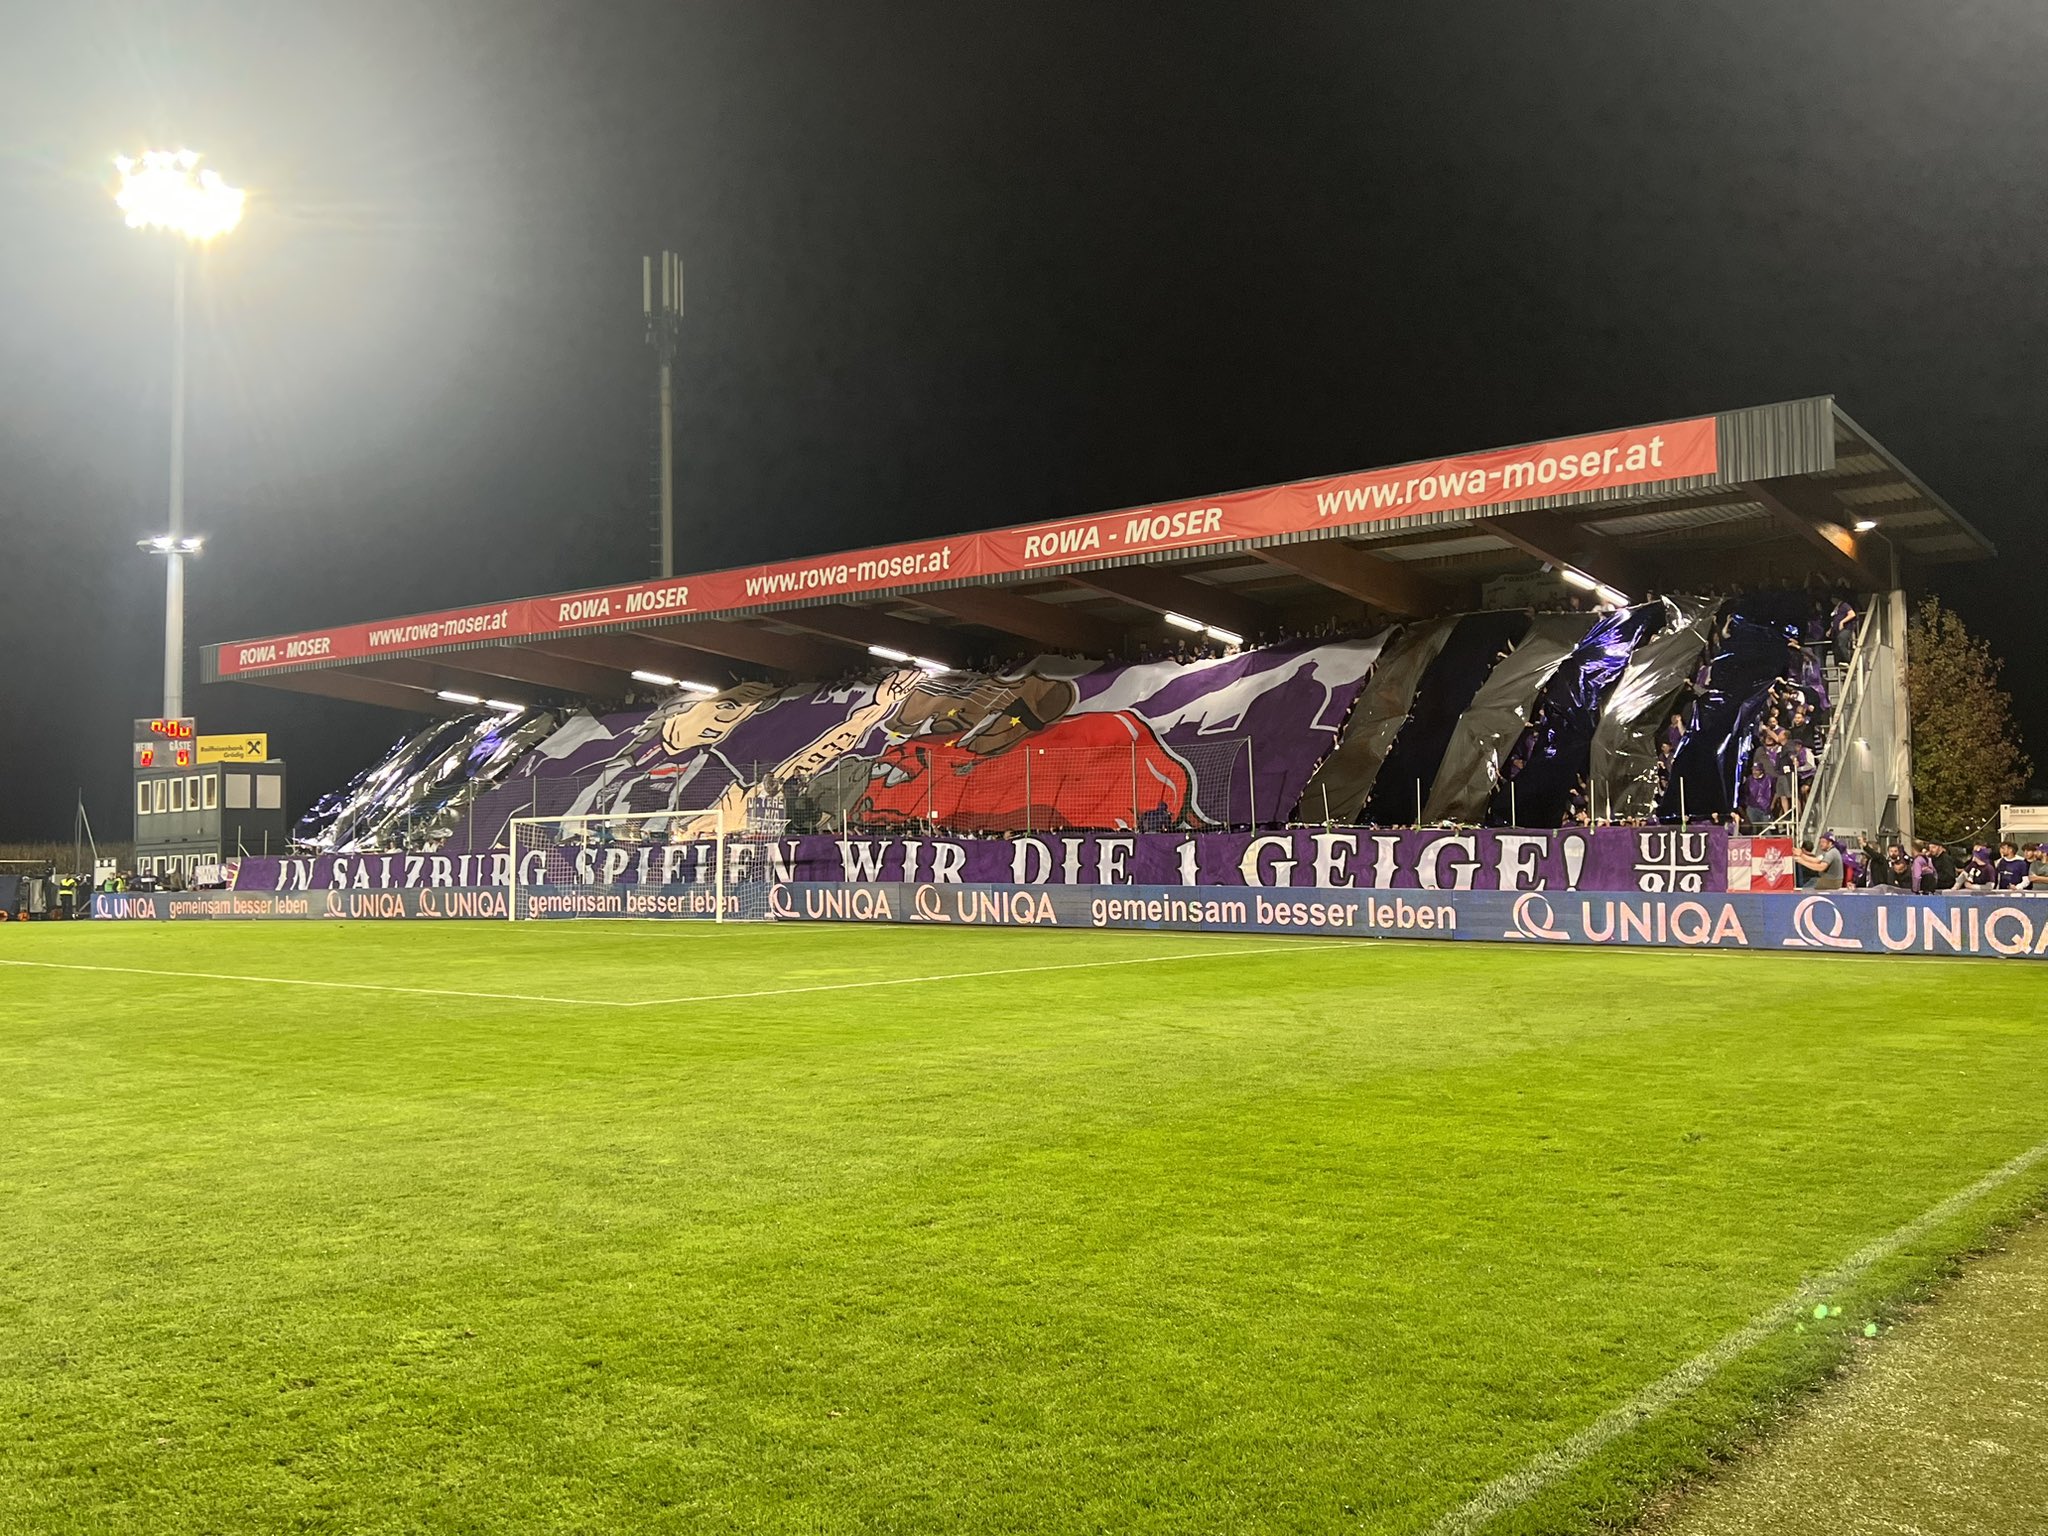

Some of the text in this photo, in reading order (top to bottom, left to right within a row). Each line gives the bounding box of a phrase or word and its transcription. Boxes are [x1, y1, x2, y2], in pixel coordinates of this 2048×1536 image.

[1316, 434, 1664, 516] www.rowa-moser.at
[1024, 526, 1100, 559] ROWA
[1124, 507, 1223, 544] MOSER
[745, 545, 951, 597] www.rowa-moser.at
[558, 598, 609, 621] ROWA
[625, 586, 688, 614] MOSER
[369, 608, 508, 647] www.rowa-moser.at
[239, 645, 276, 665] ROWA
[286, 637, 330, 659] MOSER
[169, 740, 191, 751] GÄSTE
[274, 858, 316, 891] IN
[329, 850, 547, 890] SALZBURG
[835, 839, 967, 884] WIR
[1009, 836, 1134, 886] DIE
[1238, 833, 1586, 892] GEIGE!
[114, 896, 156, 918] UNIQA
[169, 896, 308, 919] gemeinsam besser leben
[350, 893, 405, 918] UNIQA
[445, 891, 507, 918] UNIQA
[529, 890, 739, 918] gemeinsam besser leben
[806, 888, 892, 920] UNIQA
[957, 891, 1057, 925] UNIQA
[1092, 894, 1457, 930] gemeinsam besser leben
[1582, 900, 1748, 946] UNIQA
